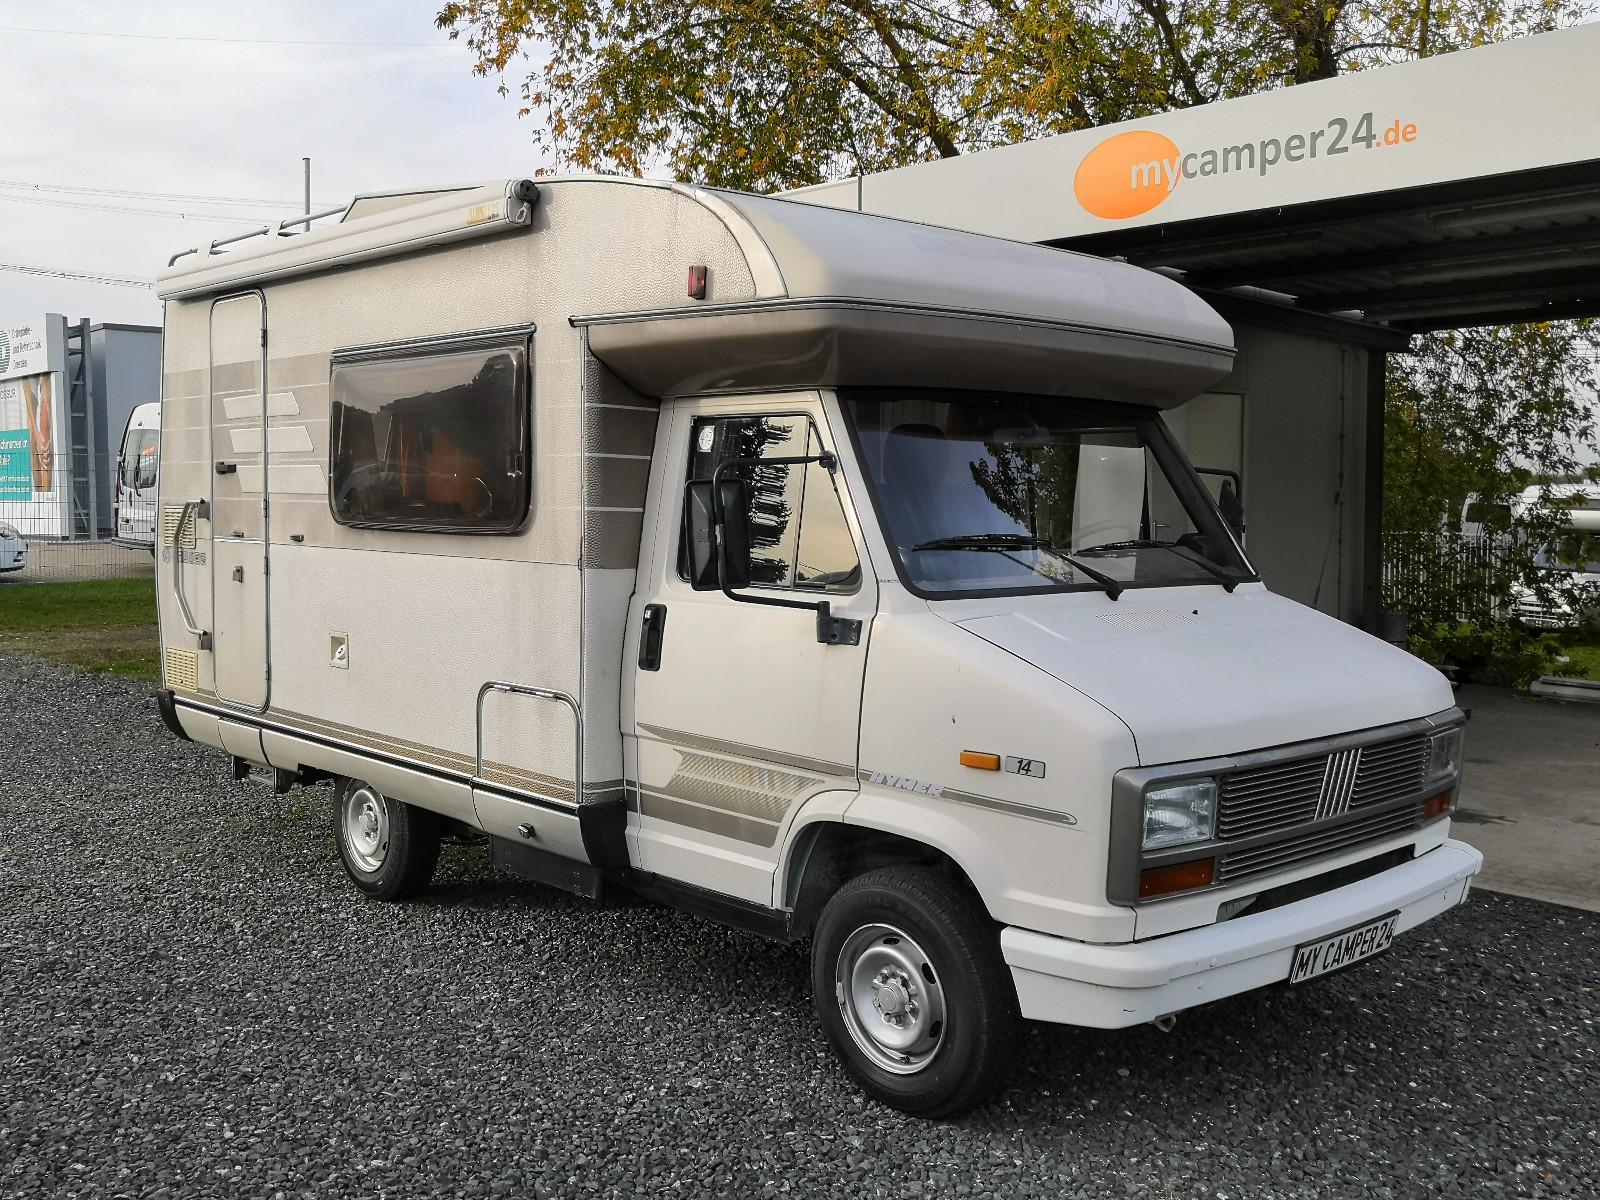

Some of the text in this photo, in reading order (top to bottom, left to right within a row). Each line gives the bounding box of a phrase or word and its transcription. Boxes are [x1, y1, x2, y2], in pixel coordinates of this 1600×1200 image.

[1016, 759, 1032, 776] 14
[869, 770, 944, 799] HYMER
[1294, 945, 1322, 980] MY
